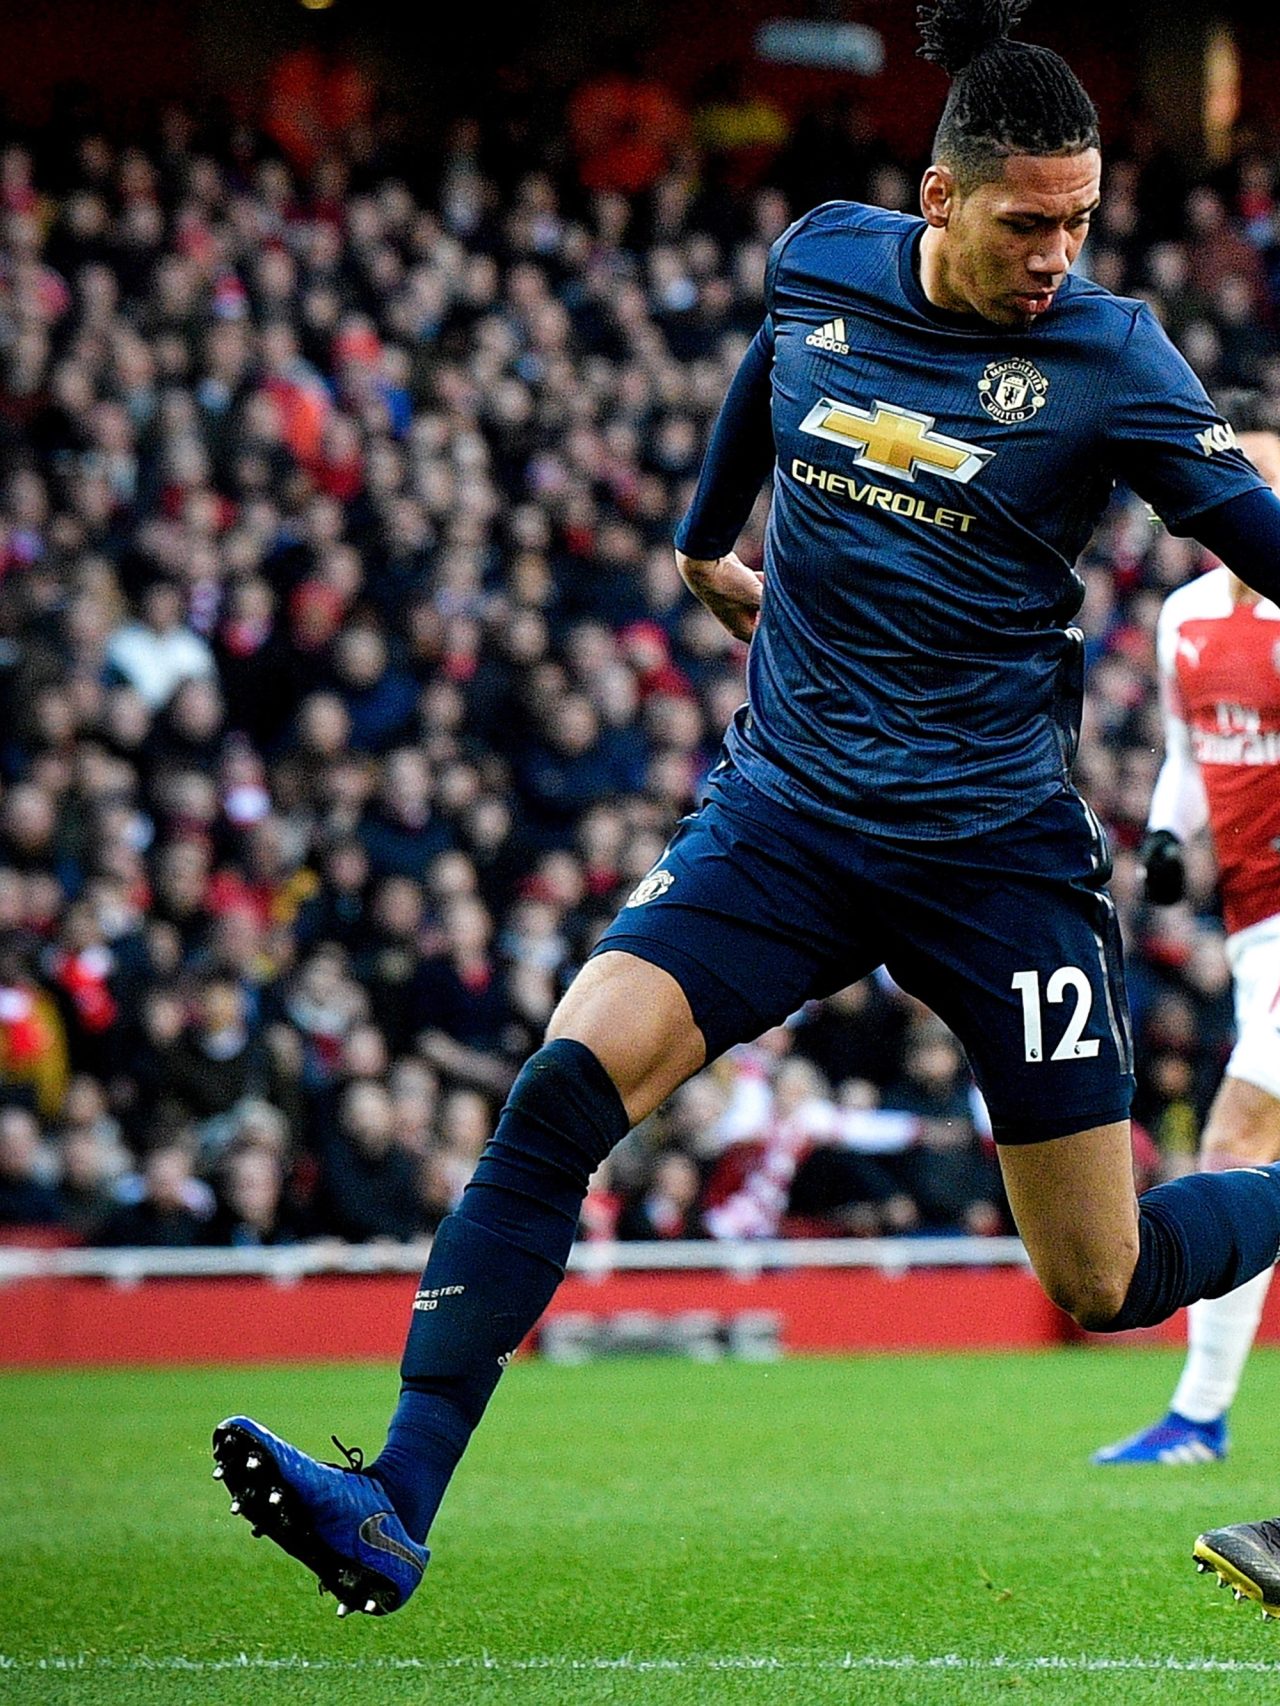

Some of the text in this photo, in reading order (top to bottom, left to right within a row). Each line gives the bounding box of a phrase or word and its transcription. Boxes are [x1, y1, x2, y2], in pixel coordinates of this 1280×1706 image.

[805, 334, 850, 355] adidas
[989, 361, 1043, 391] MANCHESTER
[987, 402, 1025, 420] UNITED
[792, 459, 976, 532] CHEVROLET
[1010, 965, 1101, 1063] 12
